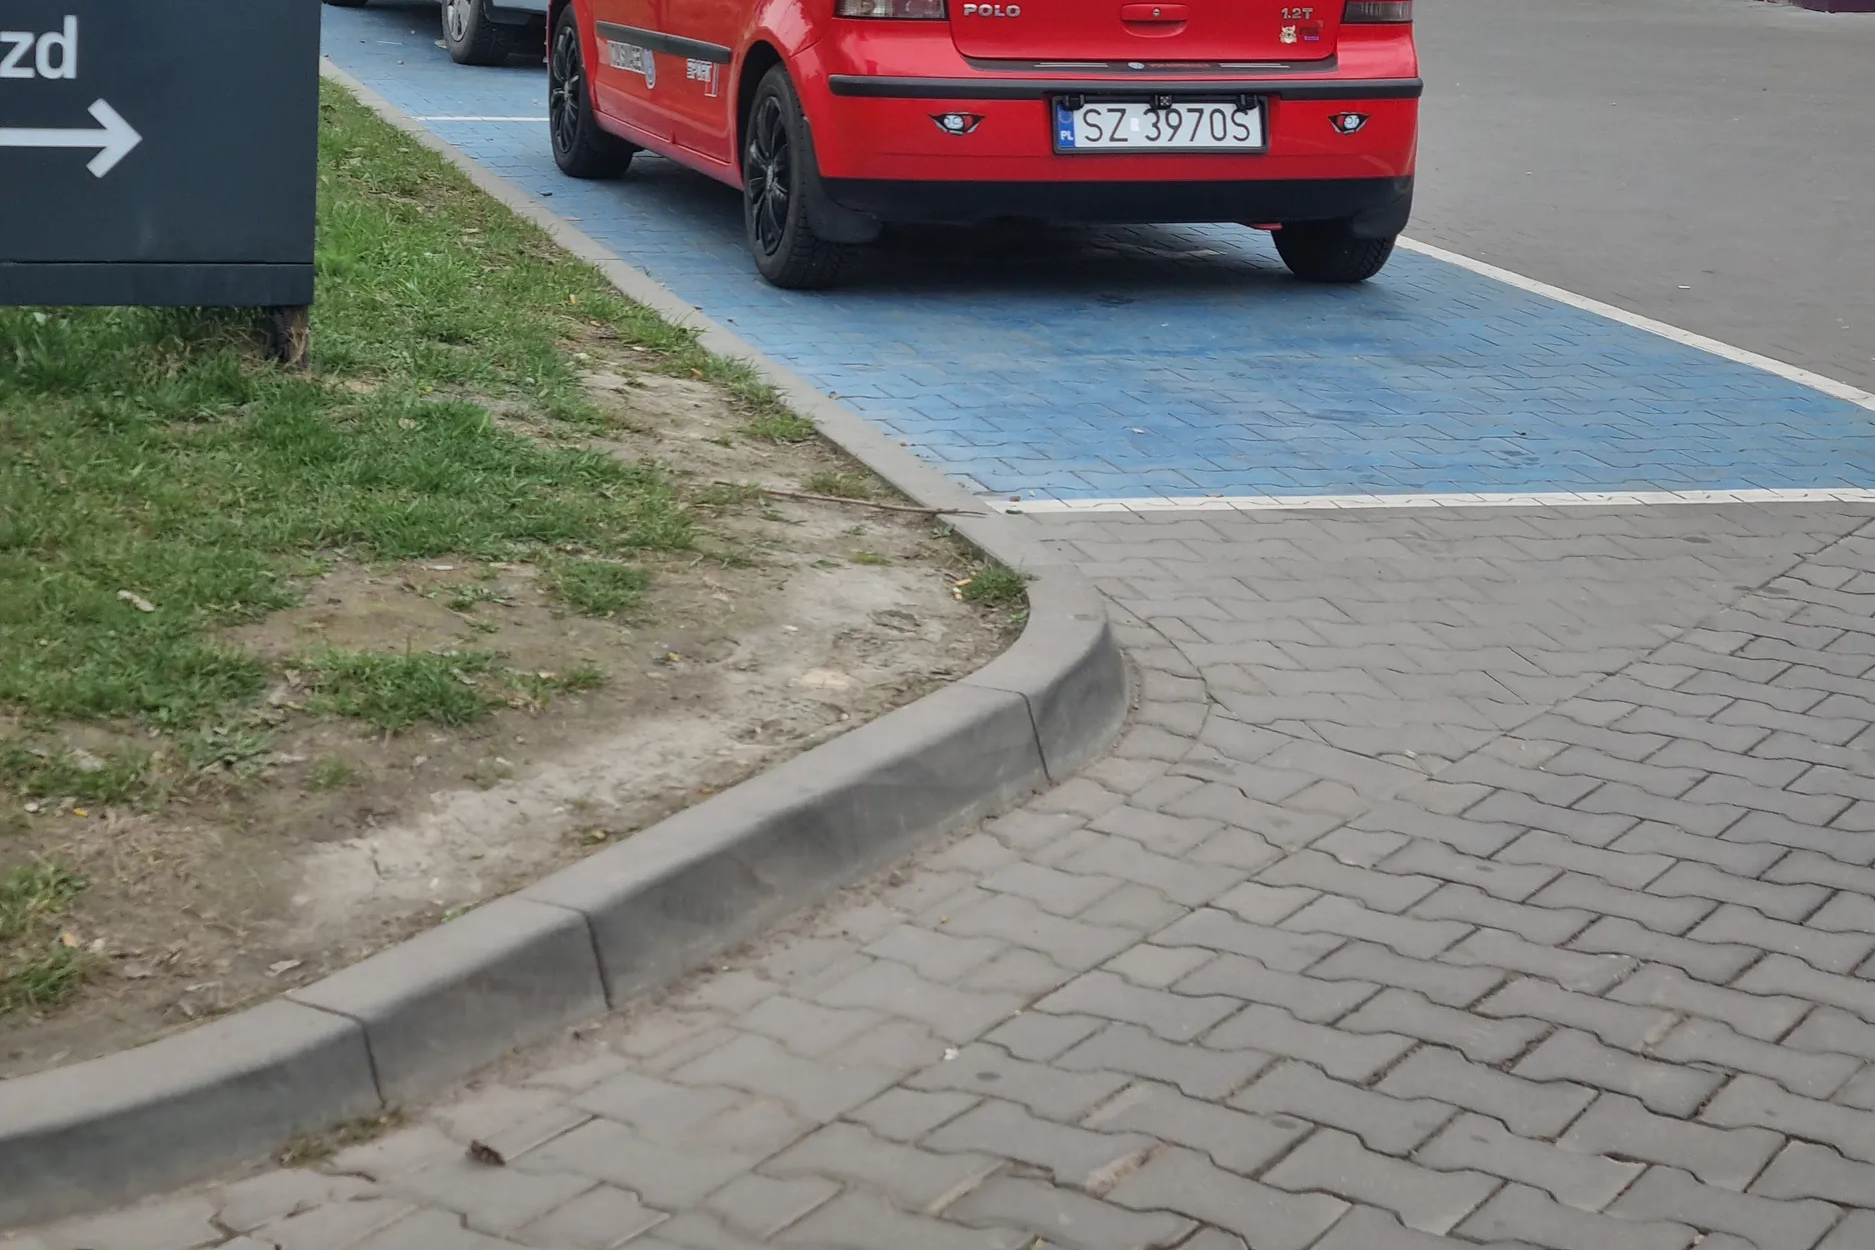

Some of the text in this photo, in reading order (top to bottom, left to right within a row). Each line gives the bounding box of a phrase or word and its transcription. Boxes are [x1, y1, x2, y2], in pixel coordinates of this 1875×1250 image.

[963, 3, 1021, 18] POLO
[1281, 7, 1314, 20] 1.2T
[1082, 107, 1250, 143] SZ 3970S
[1060, 130, 1074, 141] PL
